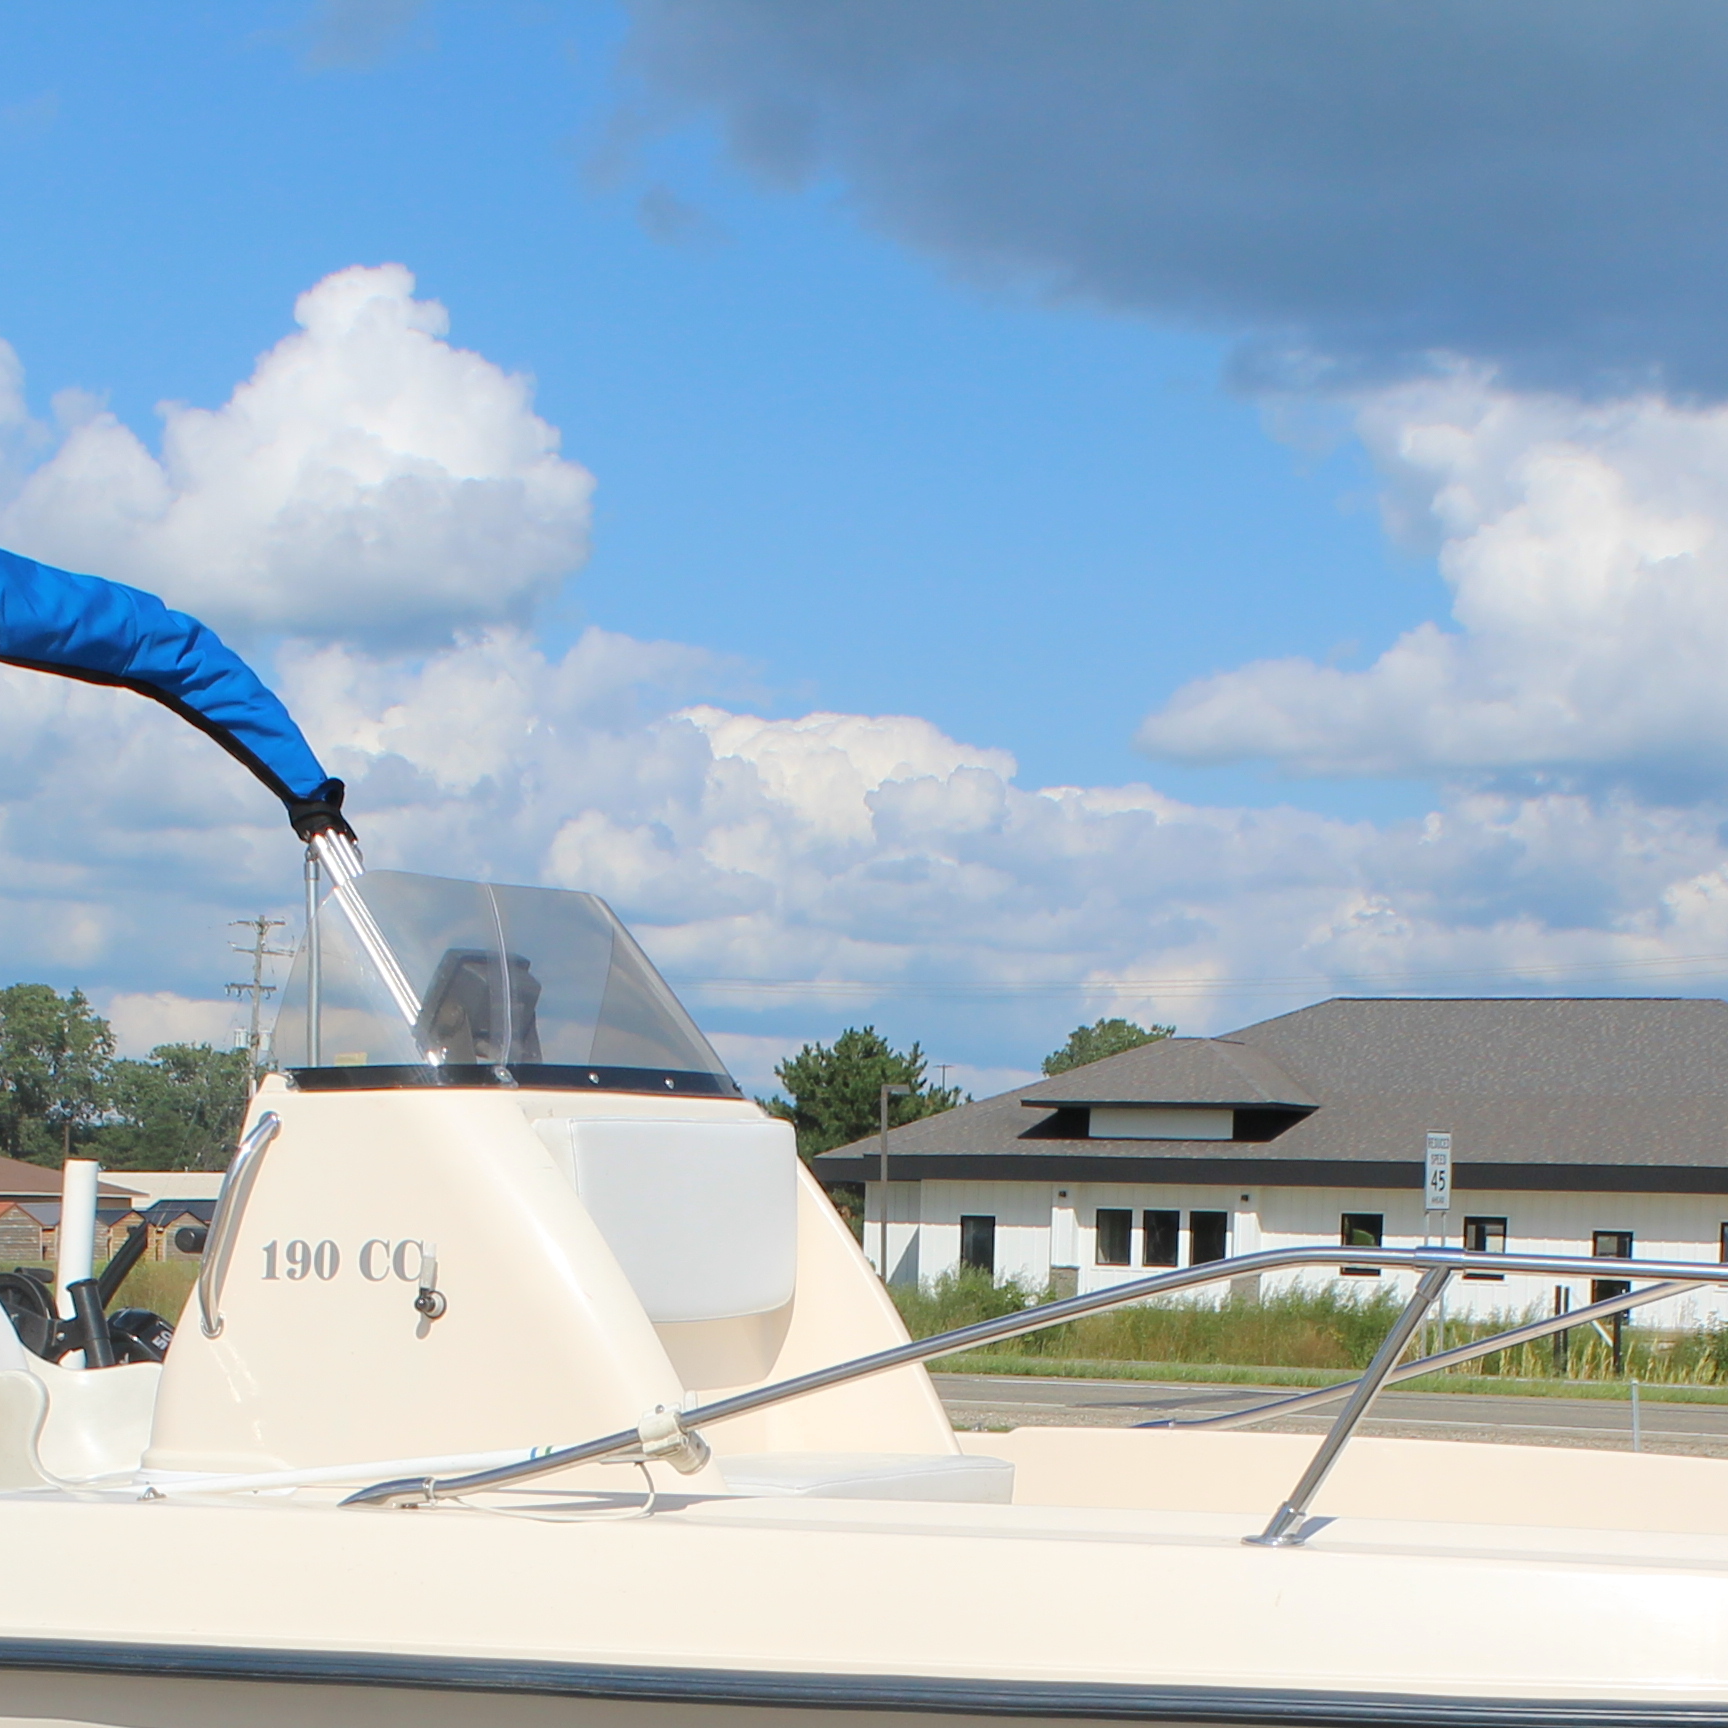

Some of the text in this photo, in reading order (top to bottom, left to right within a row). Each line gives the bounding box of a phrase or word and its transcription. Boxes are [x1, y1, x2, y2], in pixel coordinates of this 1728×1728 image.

[1428, 1138, 1449, 1149] REDUCED
[1431, 1153, 1447, 1165] SPEED
[1431, 1169, 1446, 1192] 45
[261, 1238, 424, 1282] 190 CC
